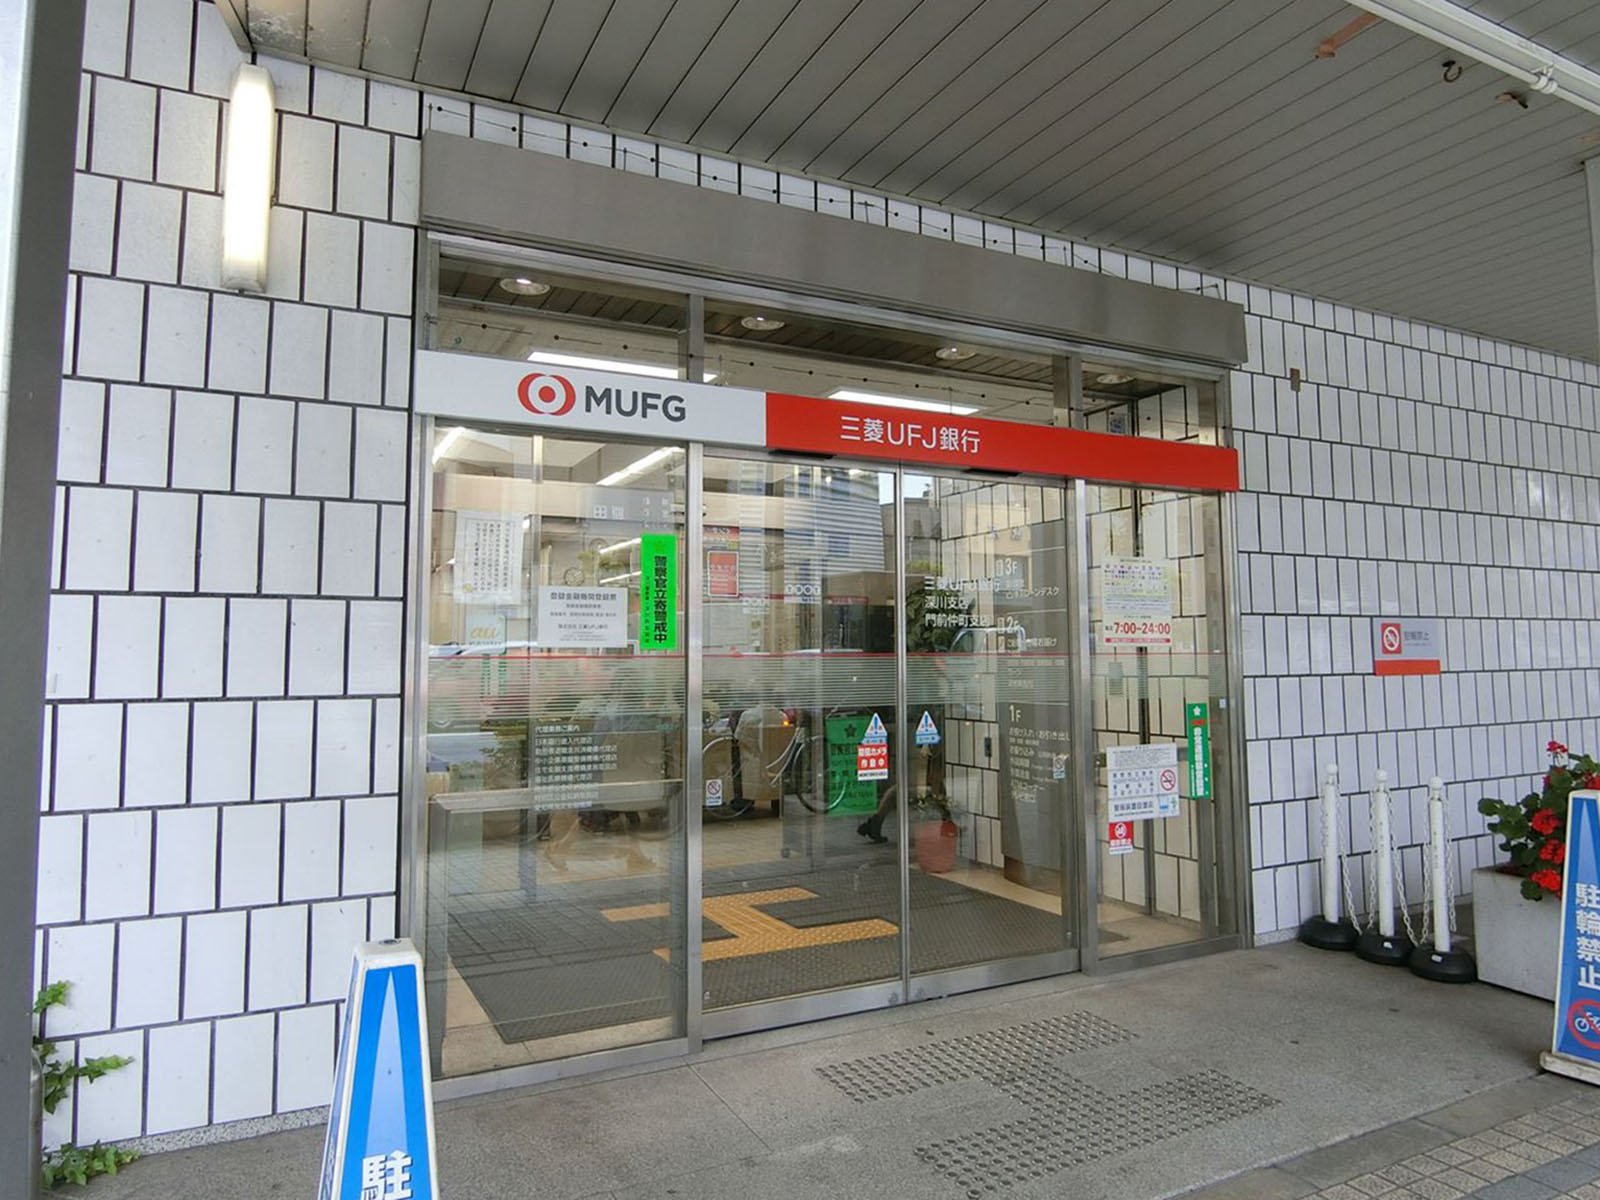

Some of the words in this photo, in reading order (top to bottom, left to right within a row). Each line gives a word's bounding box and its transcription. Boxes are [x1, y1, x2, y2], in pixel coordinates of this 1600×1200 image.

[584, 385, 687, 422] MUFG
[840, 415, 980, 453] 三菱UFJ銀行
[654, 555, 668, 644] 警察官立寄警戒中
[924, 596, 969, 609] 深川支店
[1009, 704, 1021, 722] 1F
[361, 1149, 413, 1200] 駐
